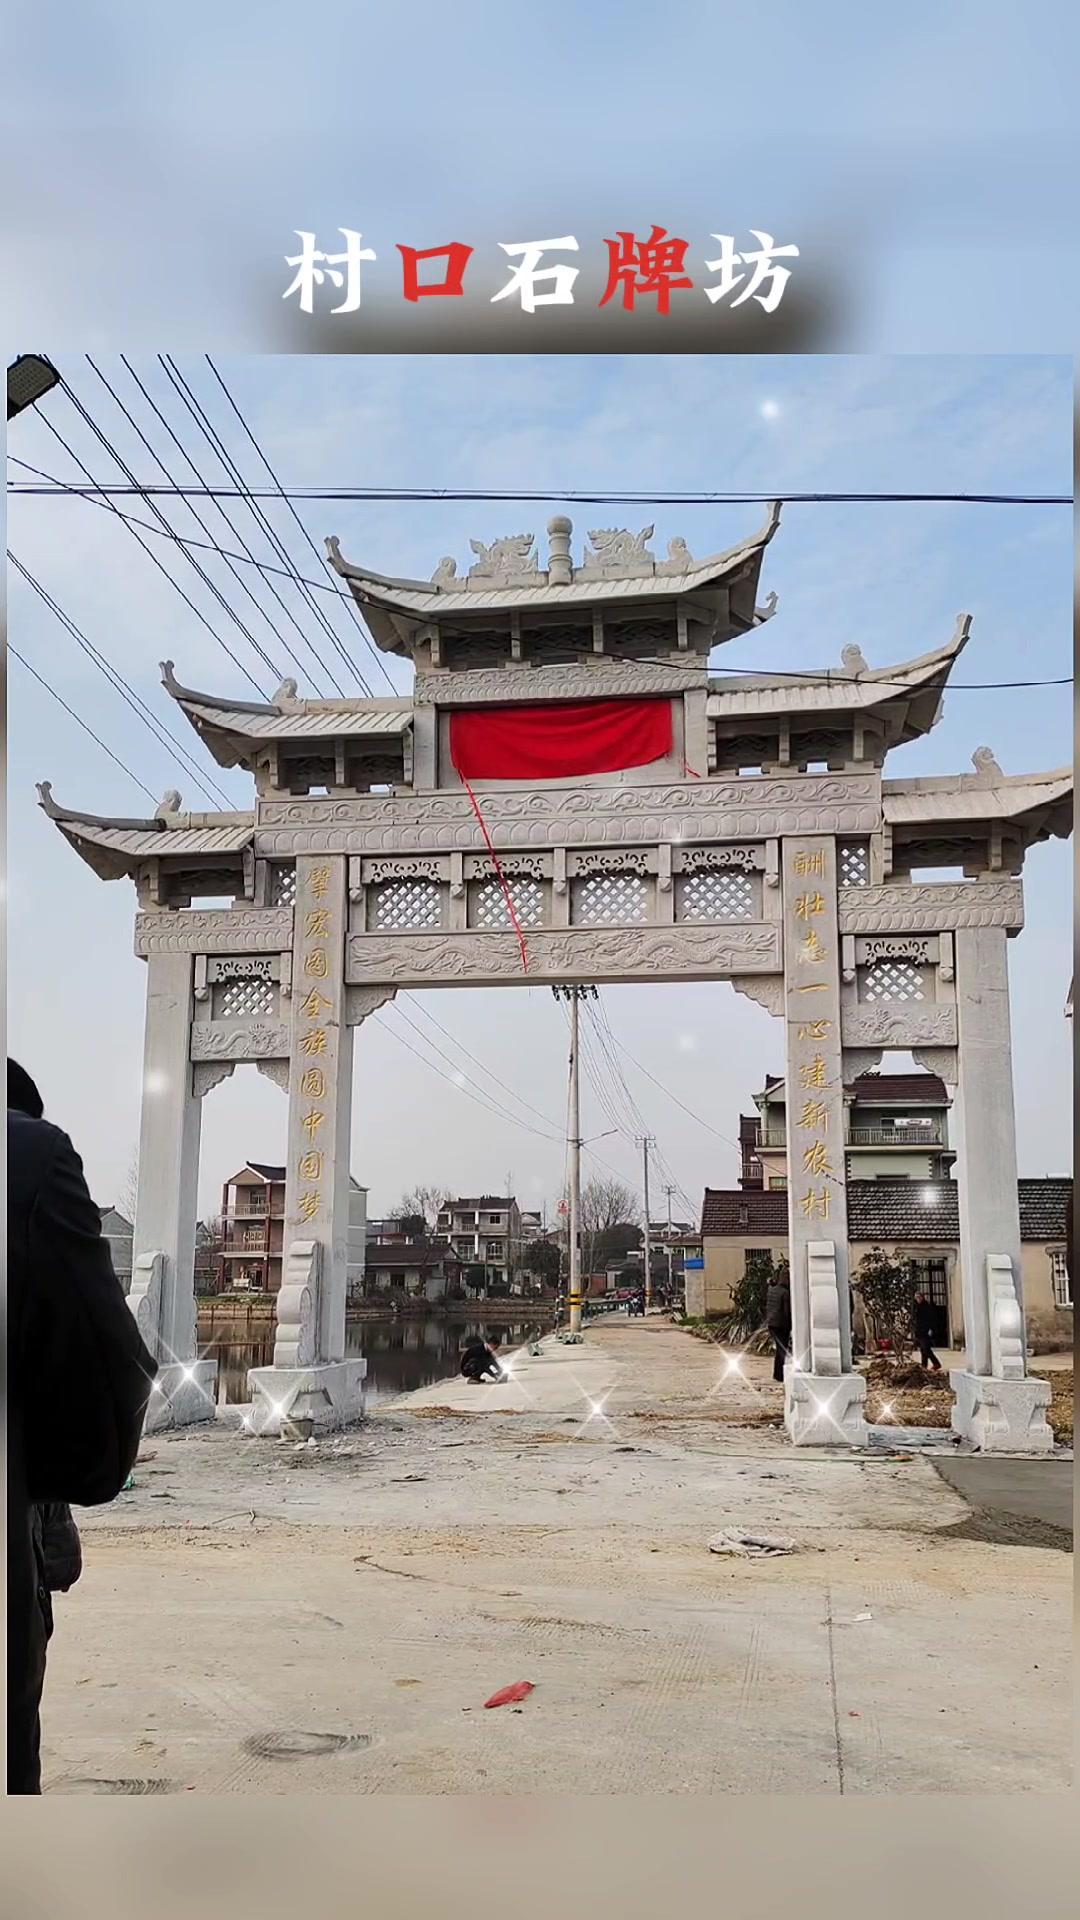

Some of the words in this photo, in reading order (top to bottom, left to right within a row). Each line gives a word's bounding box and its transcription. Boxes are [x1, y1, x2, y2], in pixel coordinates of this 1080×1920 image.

[793, 848, 834, 1222] 酬壮志一心建新农村
